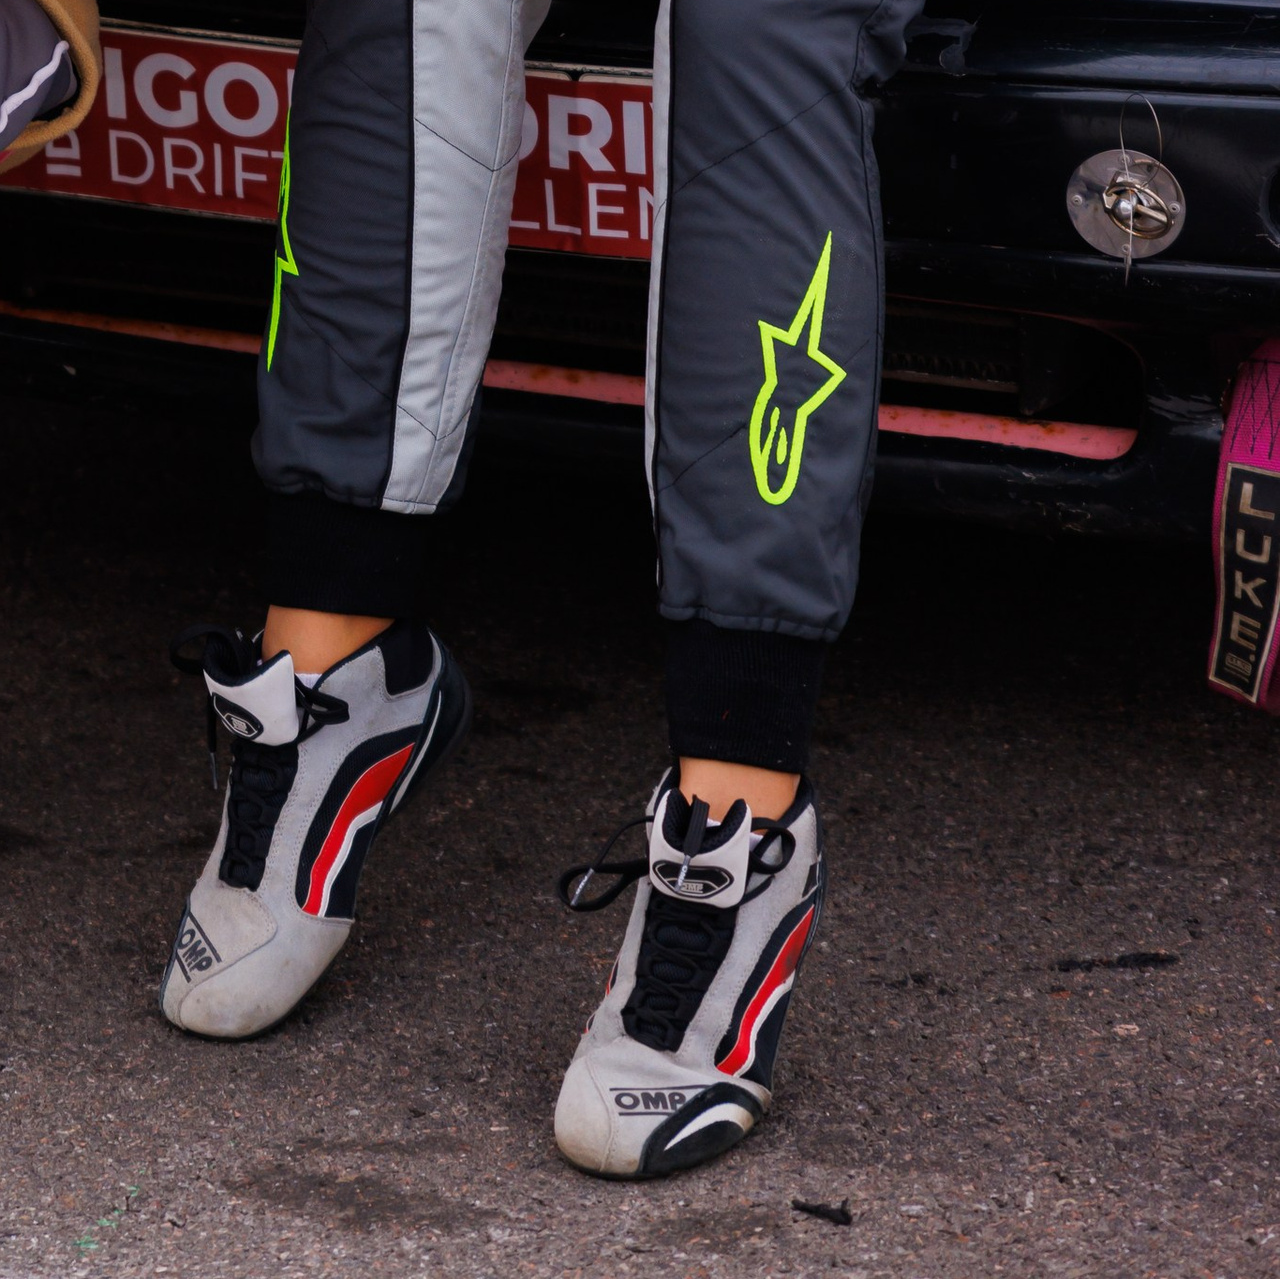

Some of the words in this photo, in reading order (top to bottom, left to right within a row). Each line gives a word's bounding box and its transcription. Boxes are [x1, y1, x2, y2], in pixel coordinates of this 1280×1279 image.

[103, 46, 297, 138] IGO
[1229, 481, 1276, 652] LUKE
[177, 928, 213, 973] OMP
[614, 1091, 687, 1111] OMP
